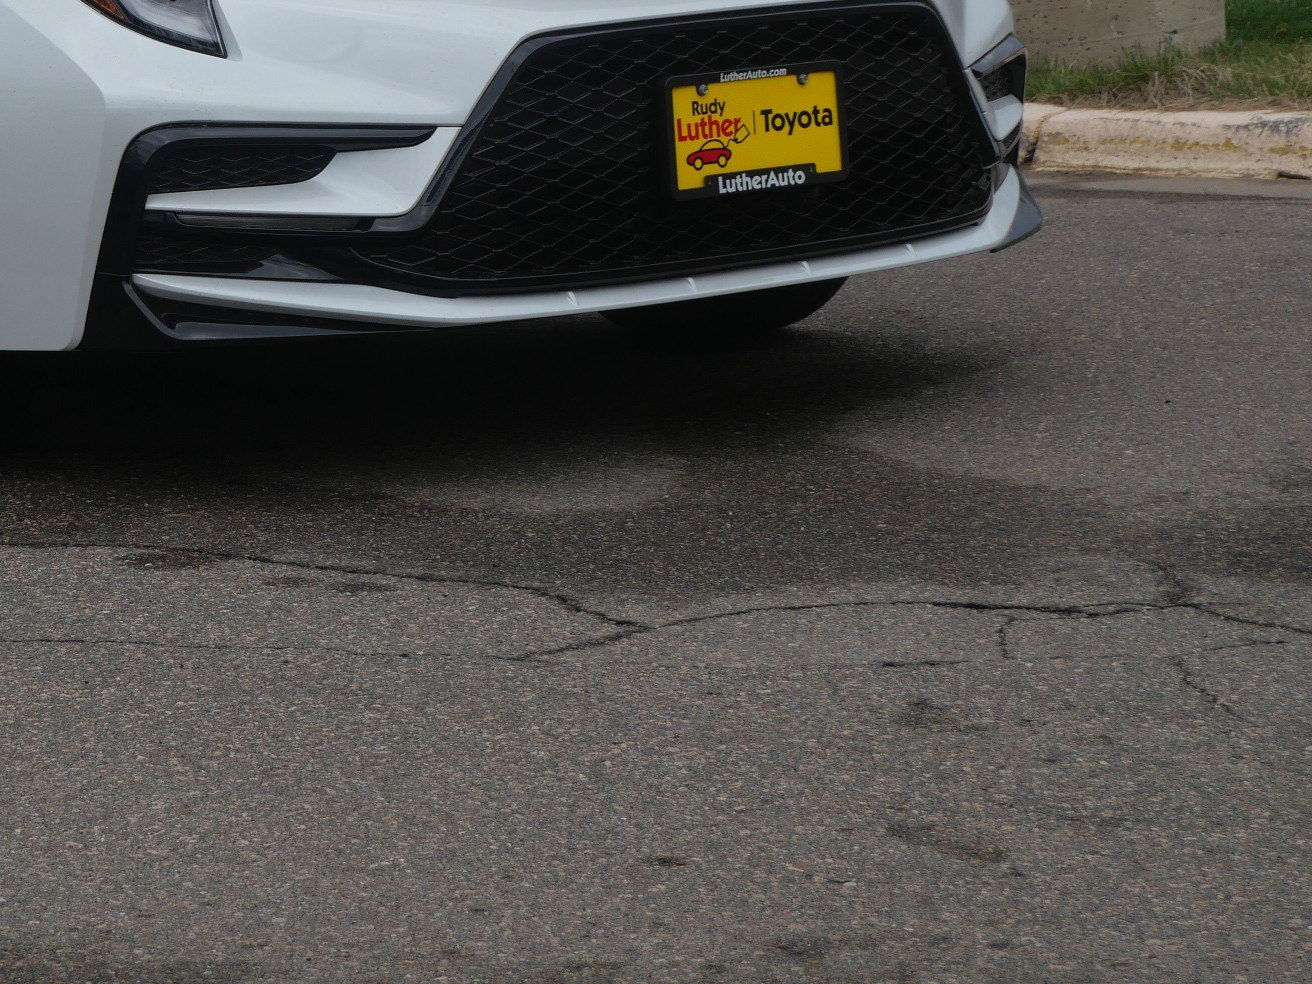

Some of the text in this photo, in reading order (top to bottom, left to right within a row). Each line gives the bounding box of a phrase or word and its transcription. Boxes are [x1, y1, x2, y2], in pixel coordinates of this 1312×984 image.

[719, 67, 787, 83] LutherAuto.com
[691, 97, 727, 117] Rudy
[676, 104, 834, 143] Luther Toyota
[718, 168, 806, 194] LutherAuto
